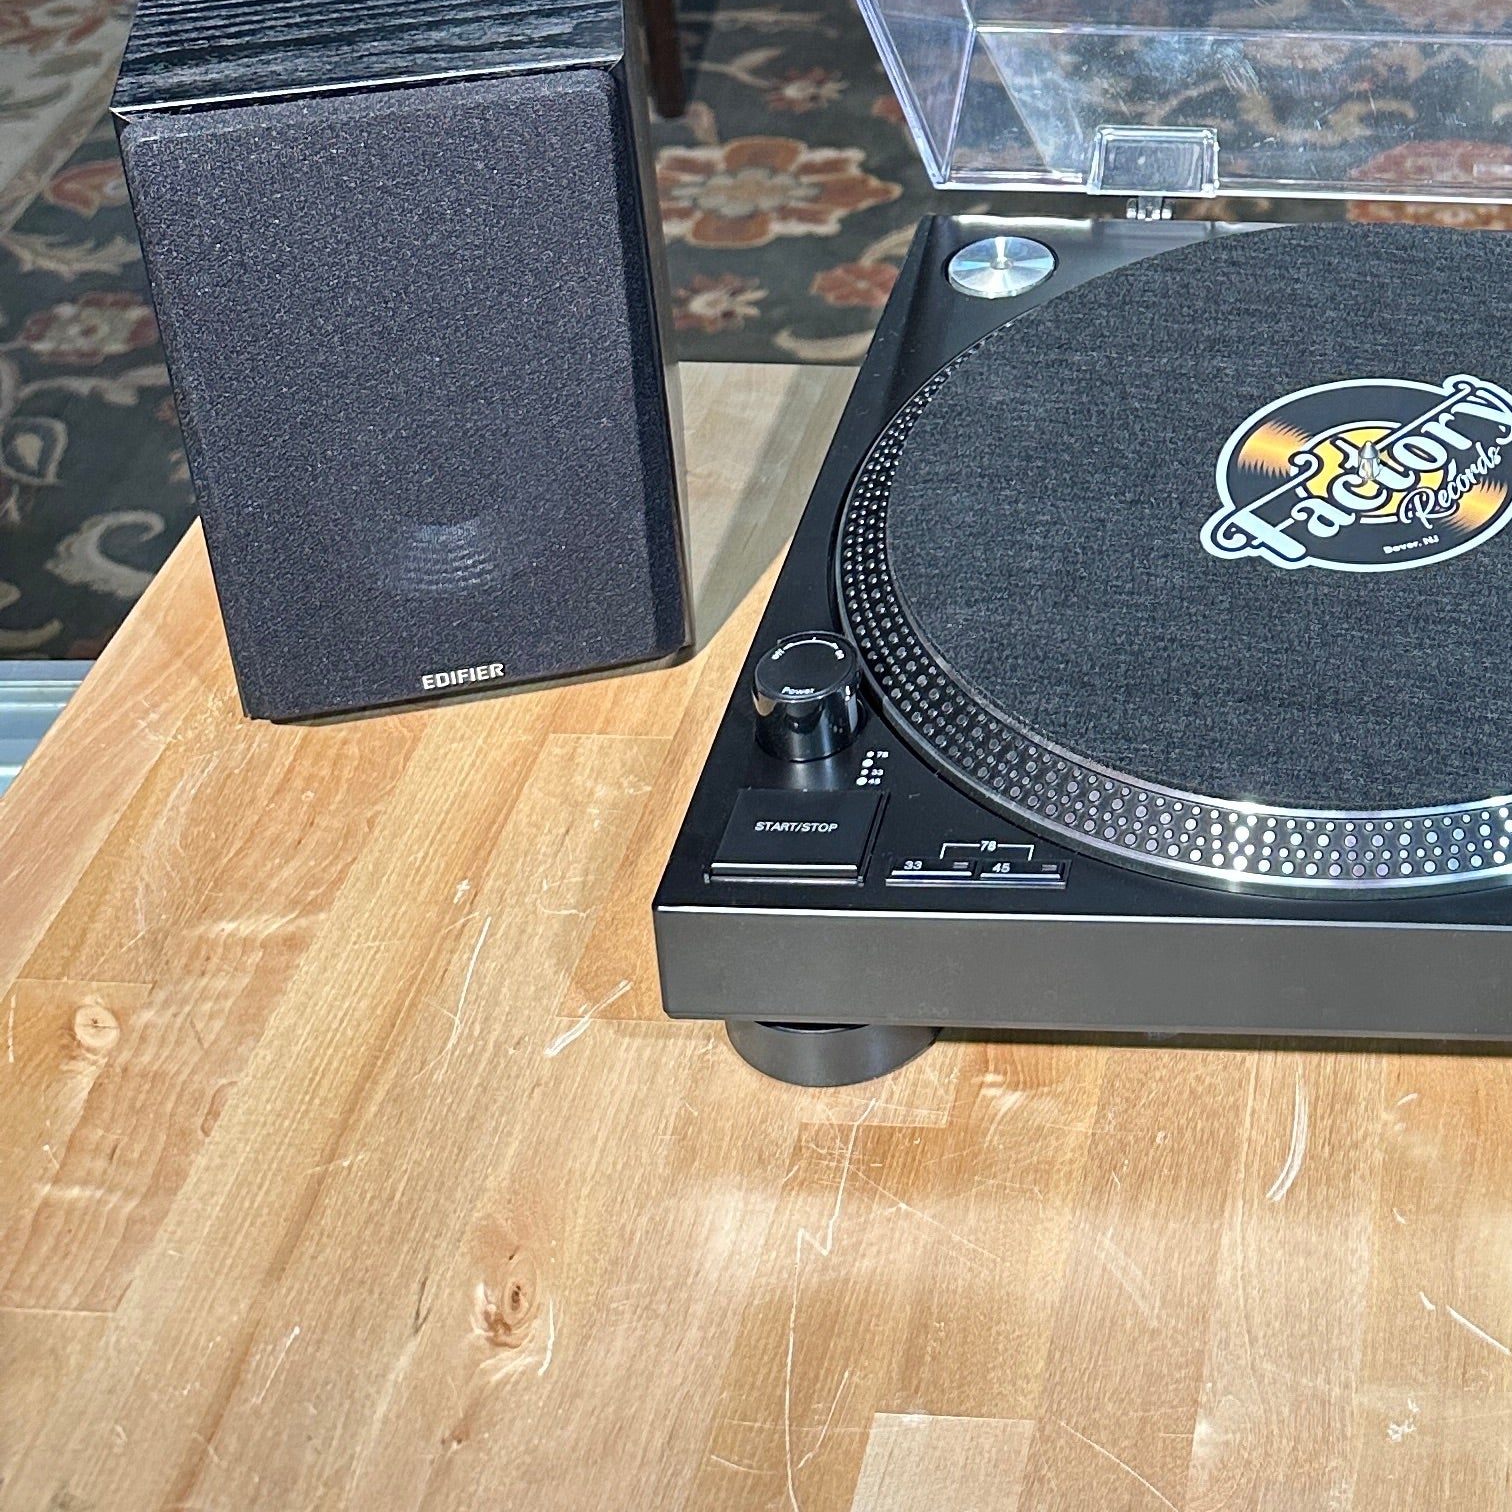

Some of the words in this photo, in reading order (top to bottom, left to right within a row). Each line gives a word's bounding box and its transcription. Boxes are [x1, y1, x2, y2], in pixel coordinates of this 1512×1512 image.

[1400, 440, 1502, 530] Records
[421, 662, 505, 691] EDIFIER
[781, 686, 815, 695] Power
[754, 821, 838, 833] START/STOP
[979, 840, 997, 852] 78
[903, 860, 923, 871] 33
[992, 862, 1011, 874] 45
